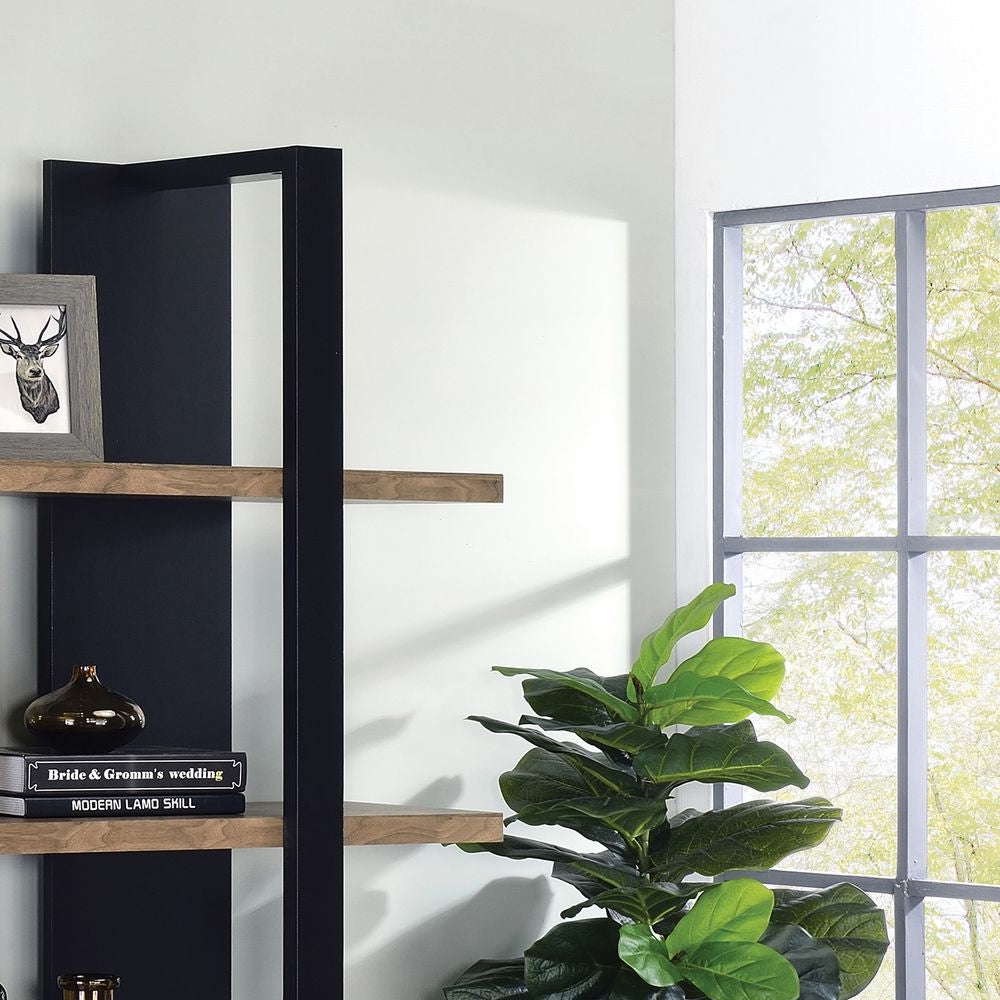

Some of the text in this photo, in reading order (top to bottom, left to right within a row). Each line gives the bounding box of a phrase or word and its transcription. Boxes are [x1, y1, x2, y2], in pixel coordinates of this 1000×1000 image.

[48, 767, 224, 781] Bride & Gromm's wedding
[71, 799, 122, 811] MODERN
[163, 797, 196, 809] SKILL
